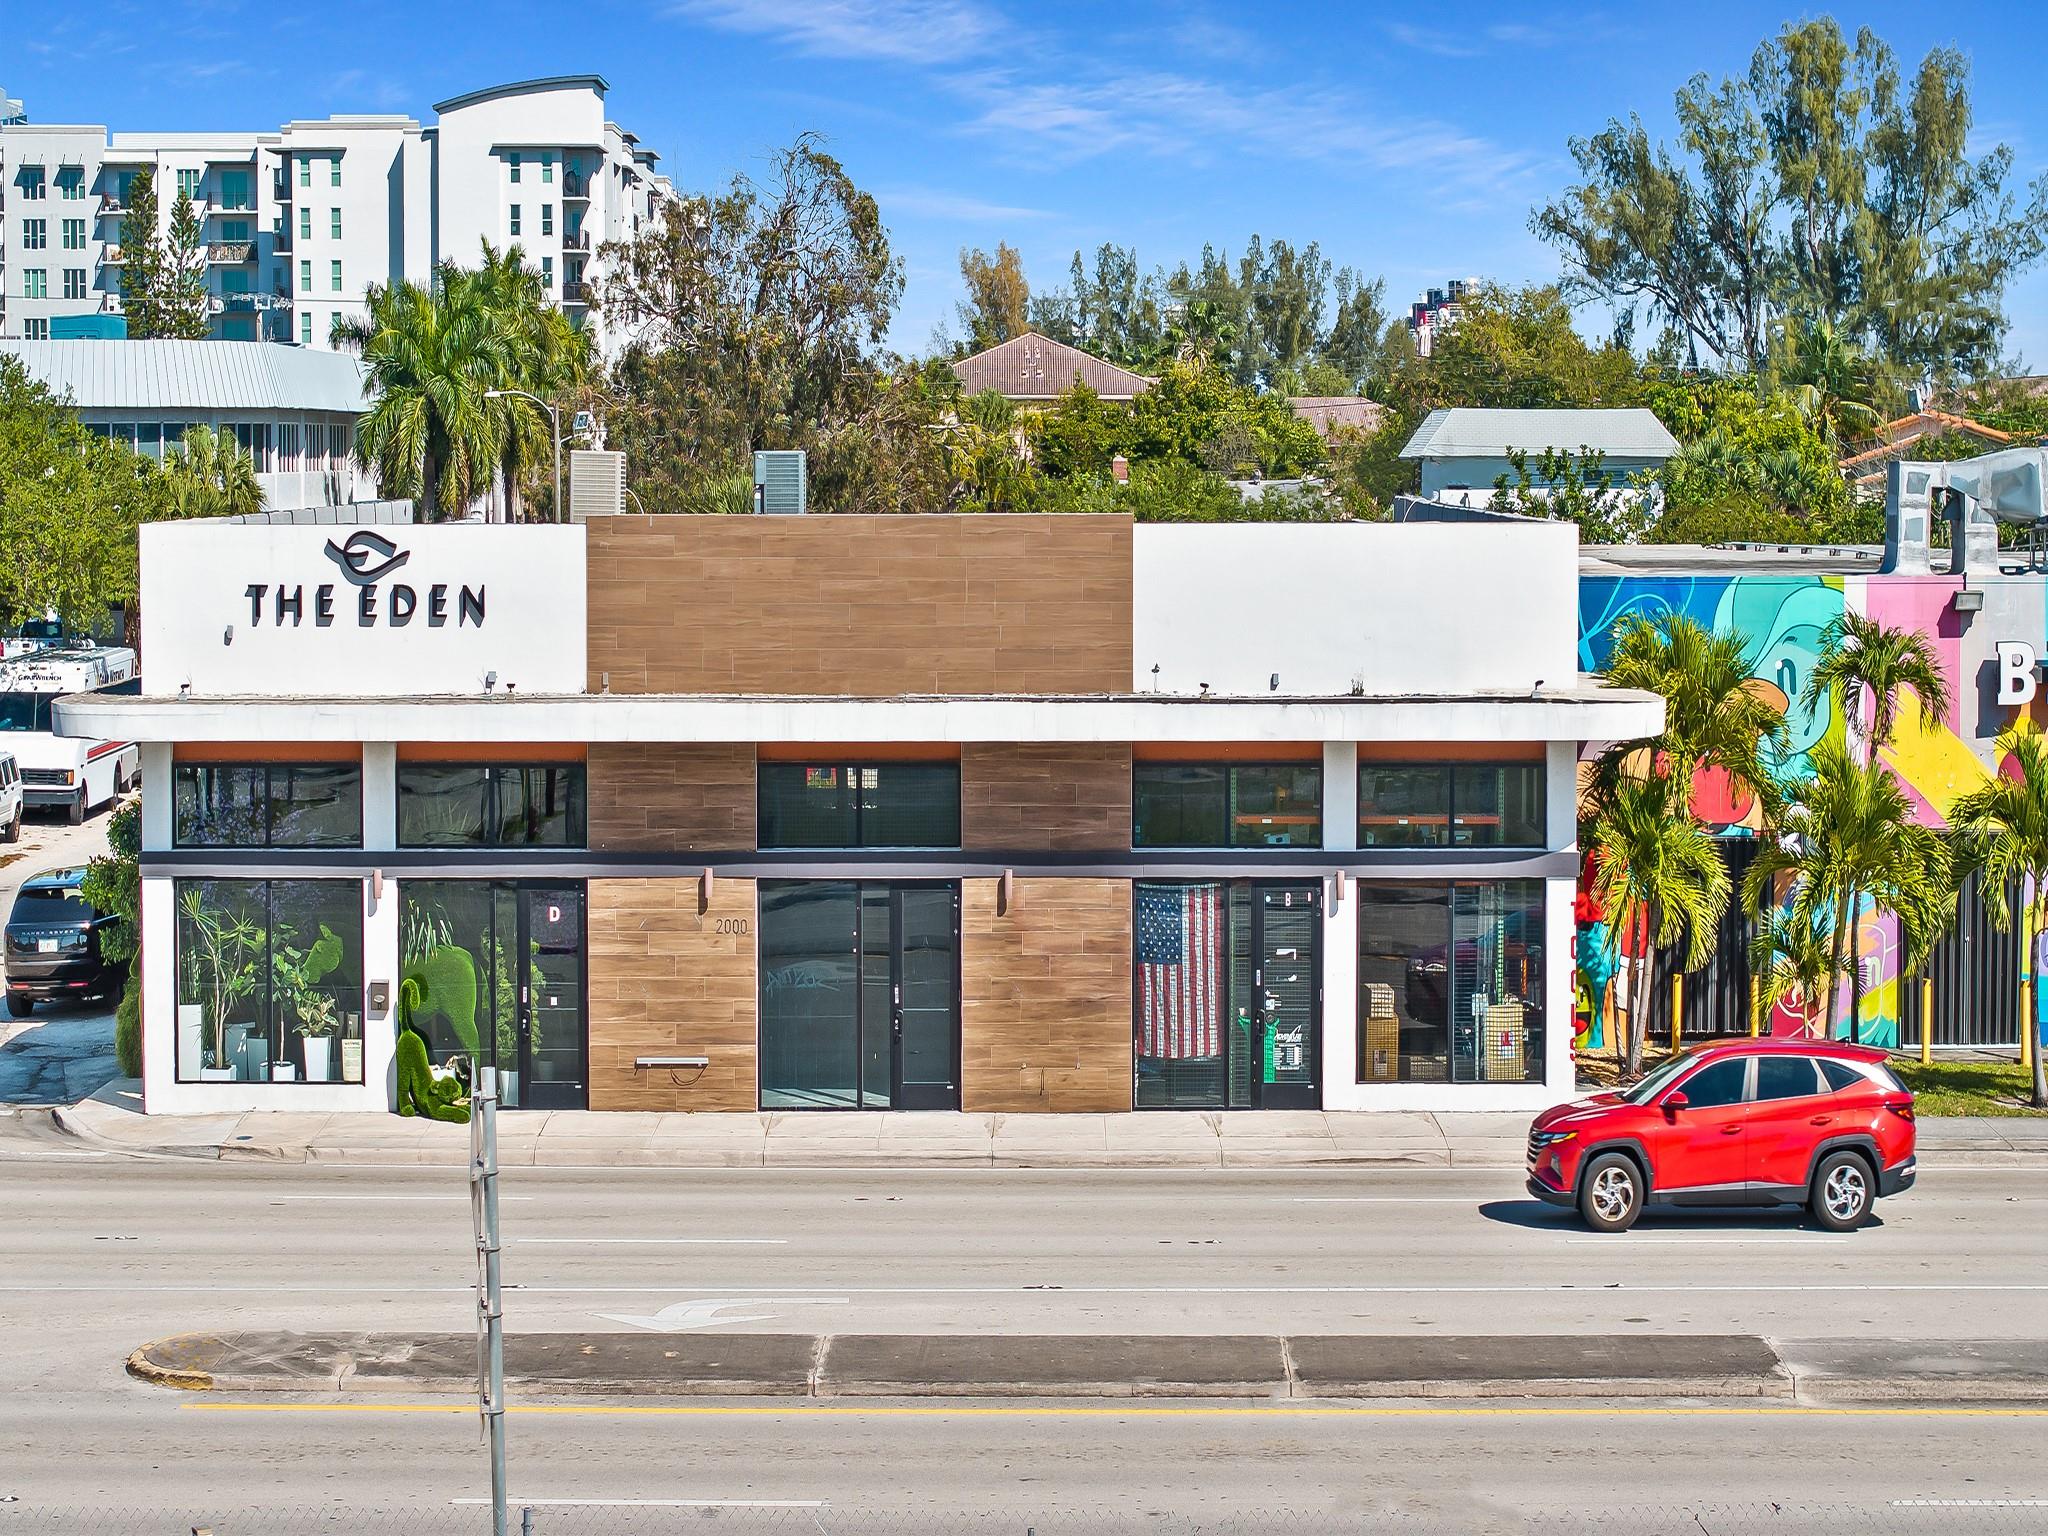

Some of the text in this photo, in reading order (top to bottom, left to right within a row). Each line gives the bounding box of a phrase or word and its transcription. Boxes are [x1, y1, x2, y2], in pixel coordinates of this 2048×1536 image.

[245, 584, 485, 627] THE EDEN
[1995, 641, 2048, 705] B
[1285, 892, 1292, 906] B
[549, 906, 561, 922] D
[716, 919, 748, 934] 2000
